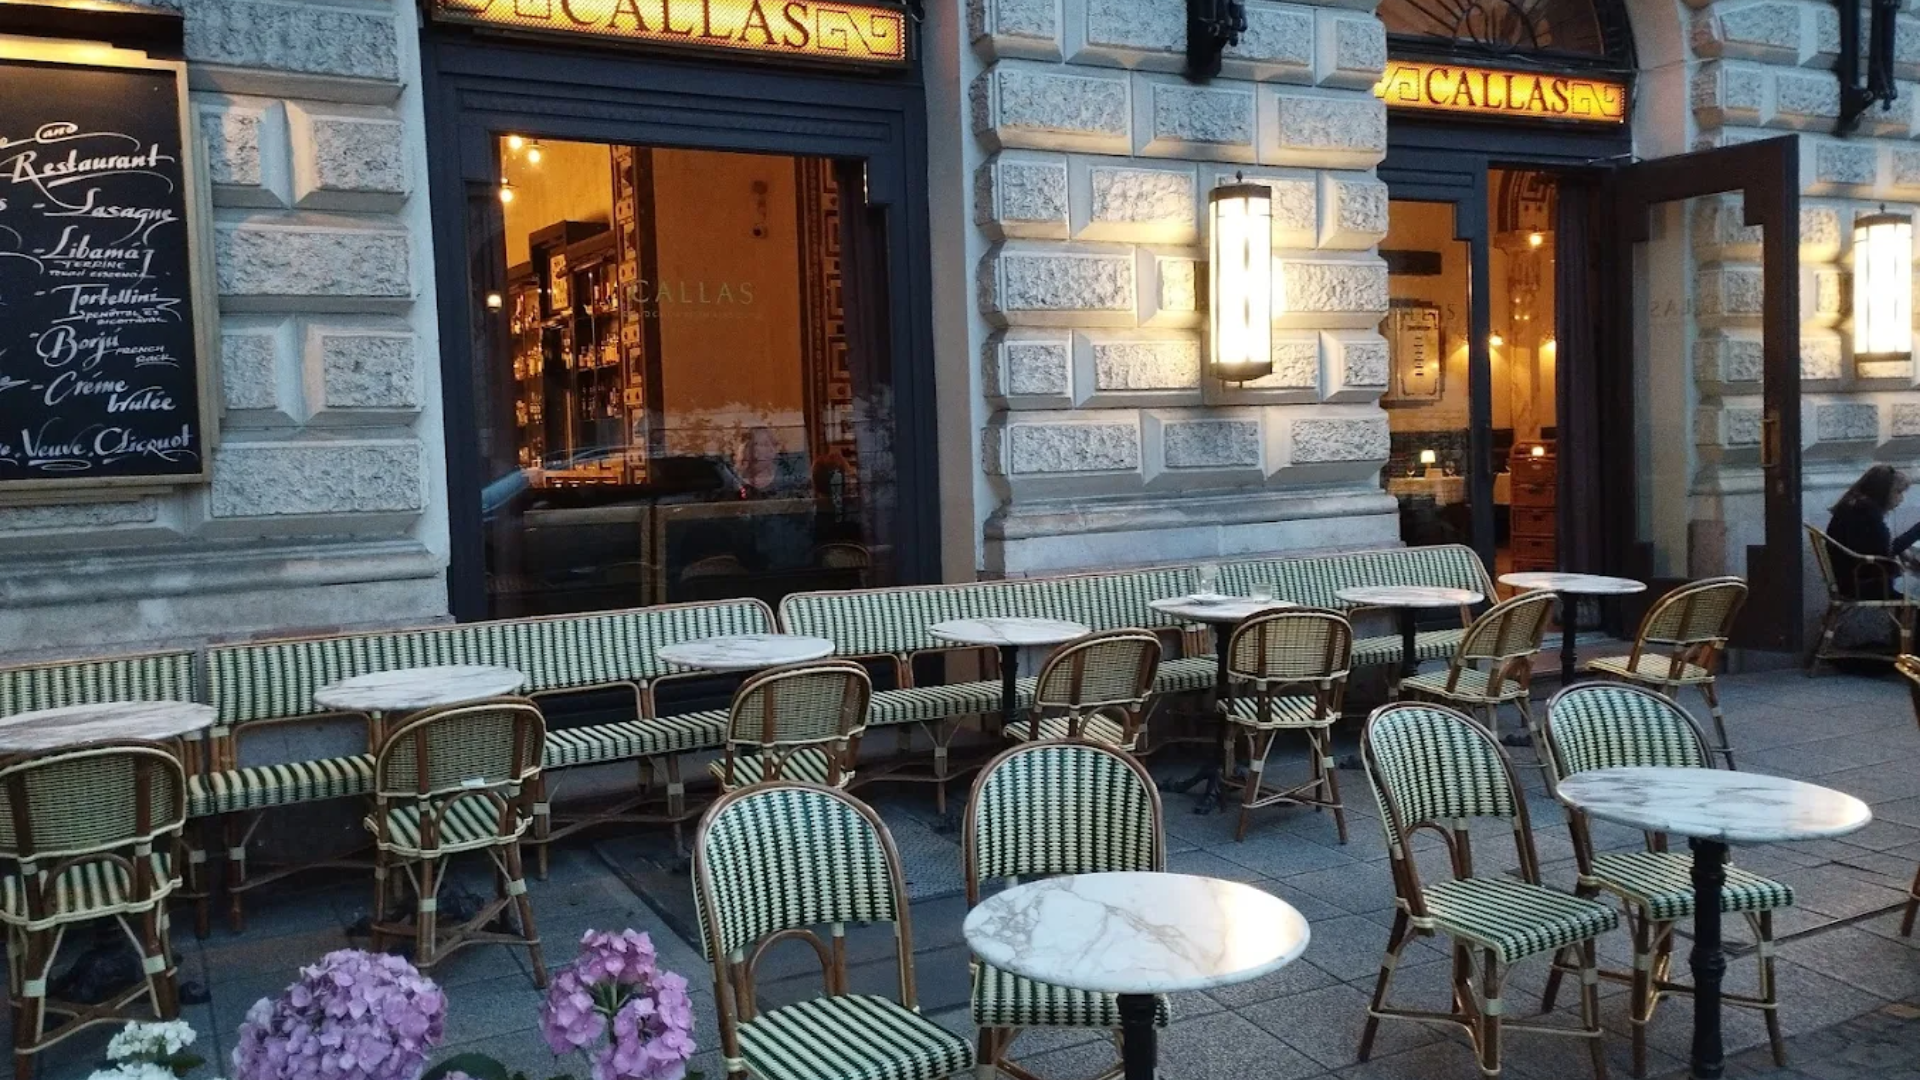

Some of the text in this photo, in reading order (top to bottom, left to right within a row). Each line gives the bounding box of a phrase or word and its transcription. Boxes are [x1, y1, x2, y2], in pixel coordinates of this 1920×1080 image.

[561, 0, 811, 49] CALLAS
[1425, 67, 1569, 114] CALLAS
[11, 143, 175, 184] Restaurant
[55, 187, 178, 235] Lasagne
[51, 283, 172, 315] Tortellini
[632, 279, 754, 305] CALLAS
